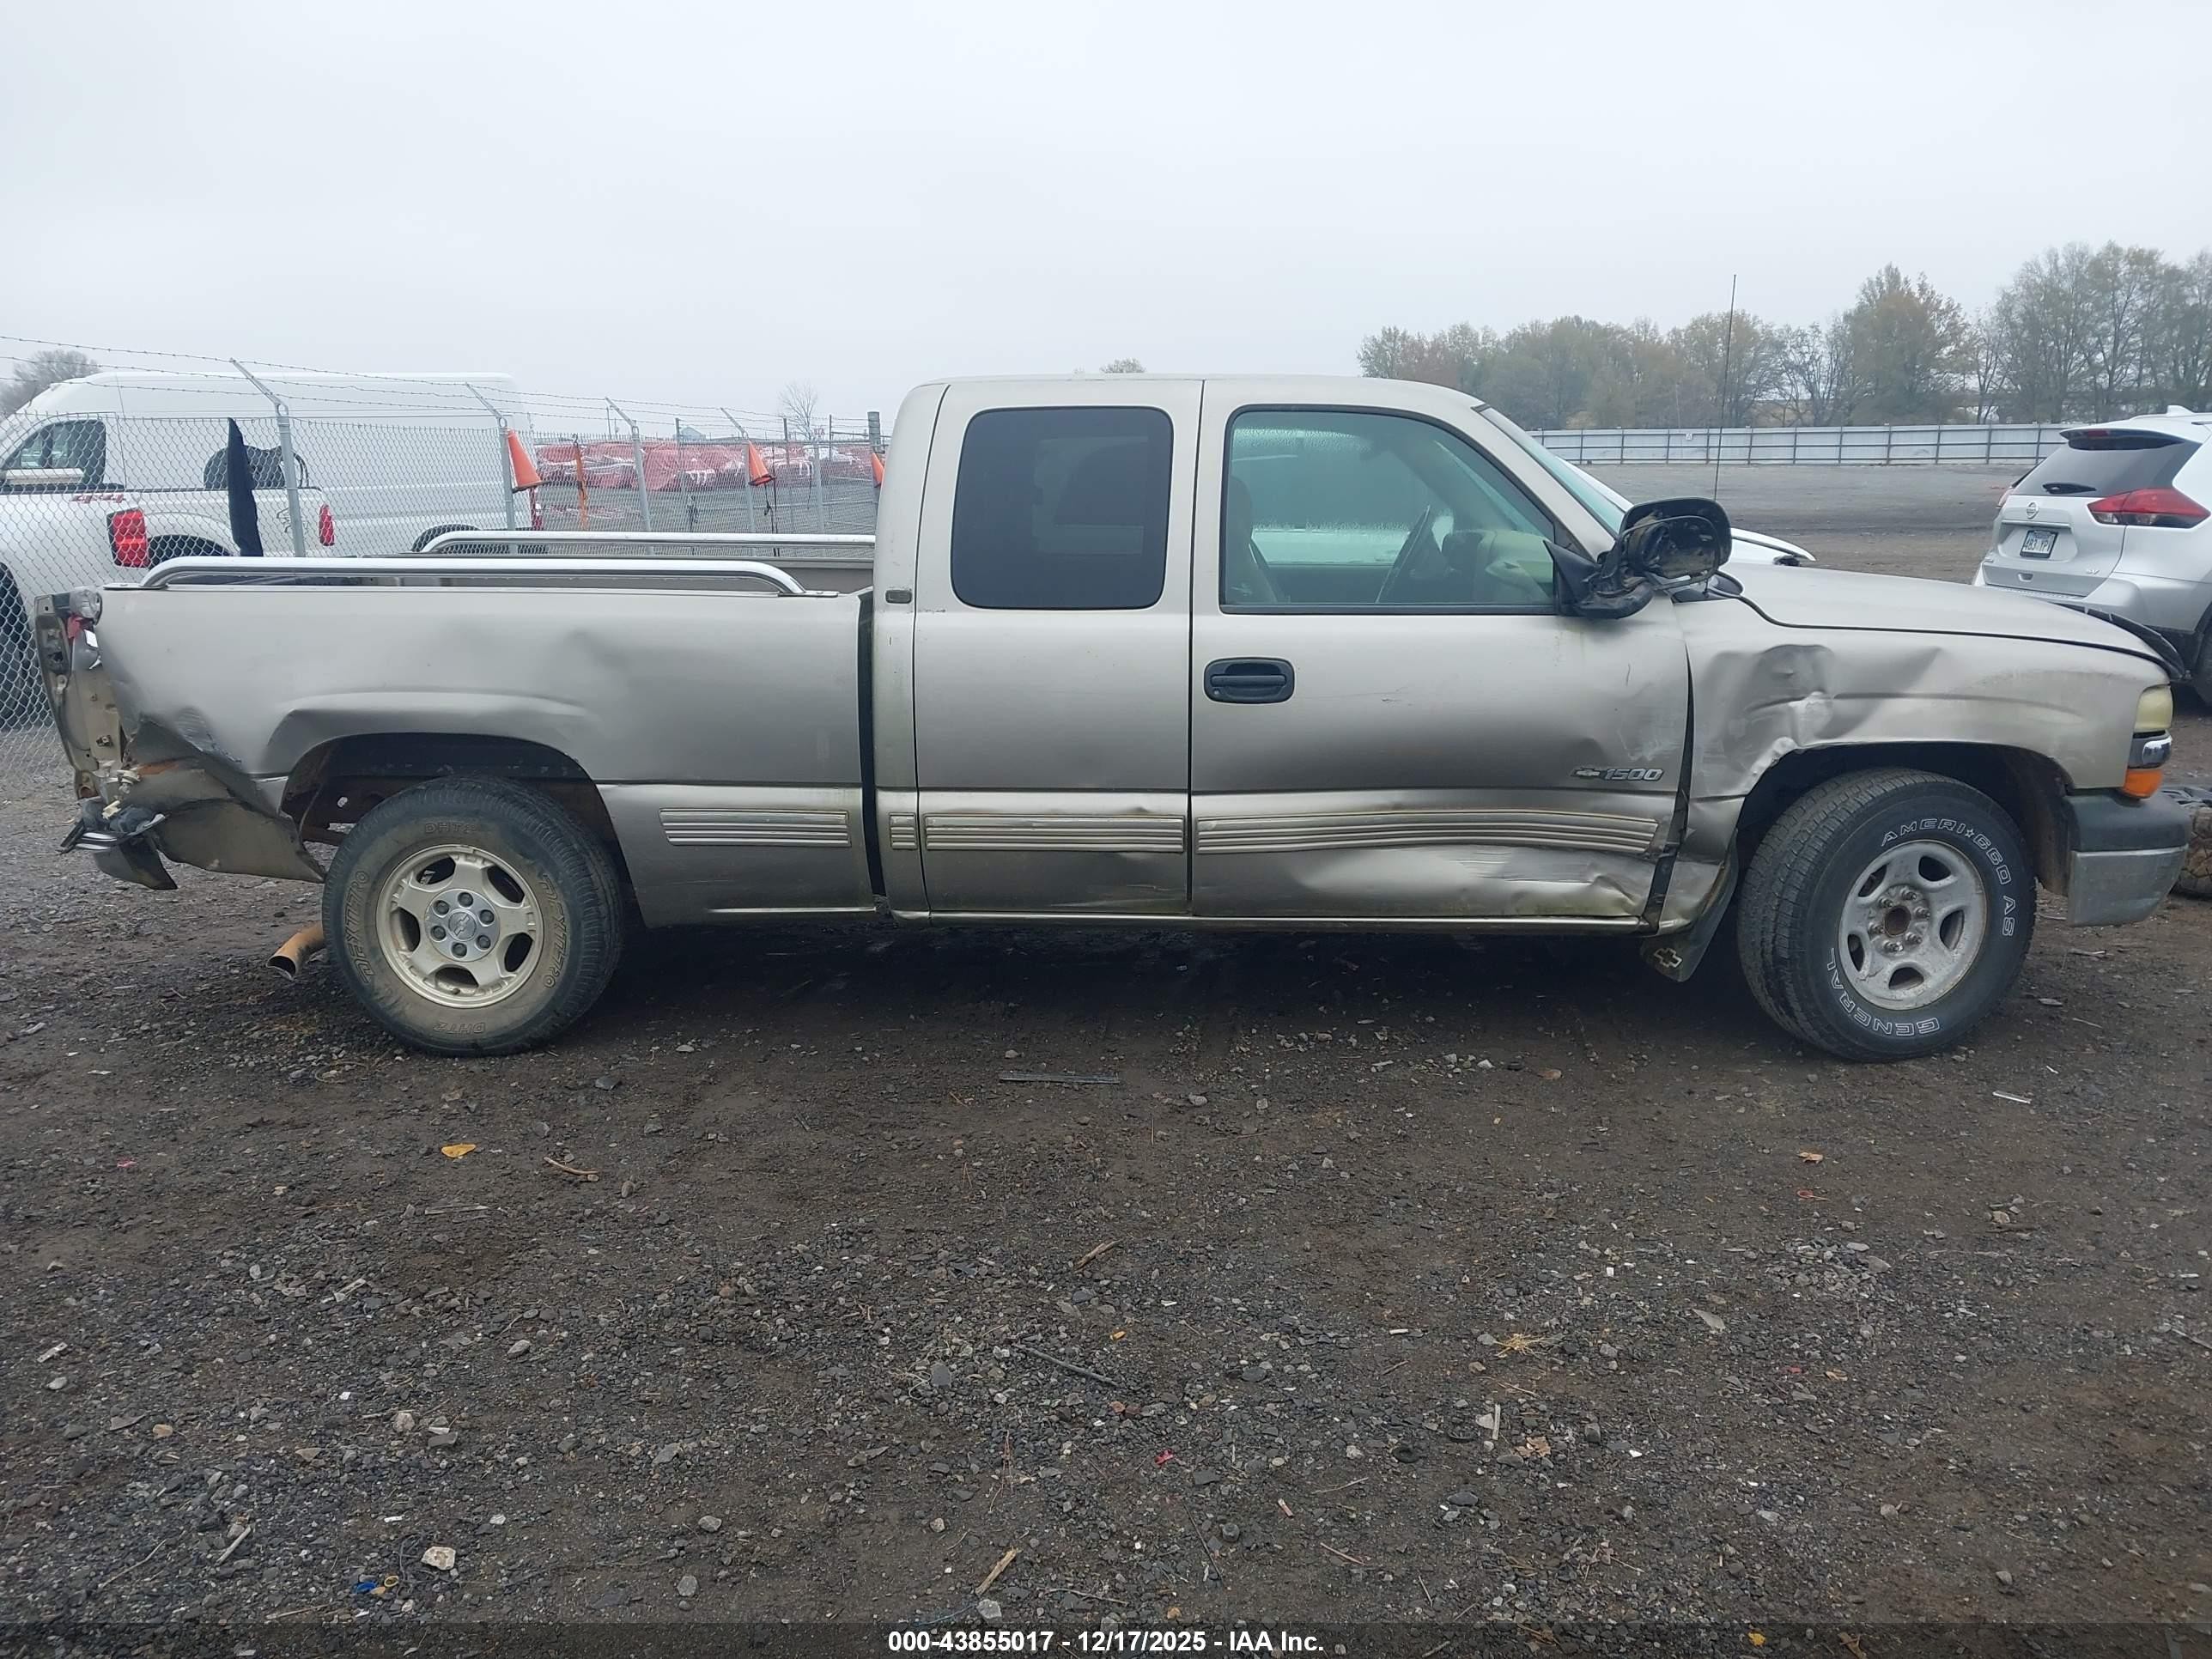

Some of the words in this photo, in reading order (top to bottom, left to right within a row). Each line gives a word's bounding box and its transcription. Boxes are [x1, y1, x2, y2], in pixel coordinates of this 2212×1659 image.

[1603, 768, 1664, 781] 1500
[2002, 895, 2016, 936] AS
[1826, 947, 1940, 1036] GENERAL
